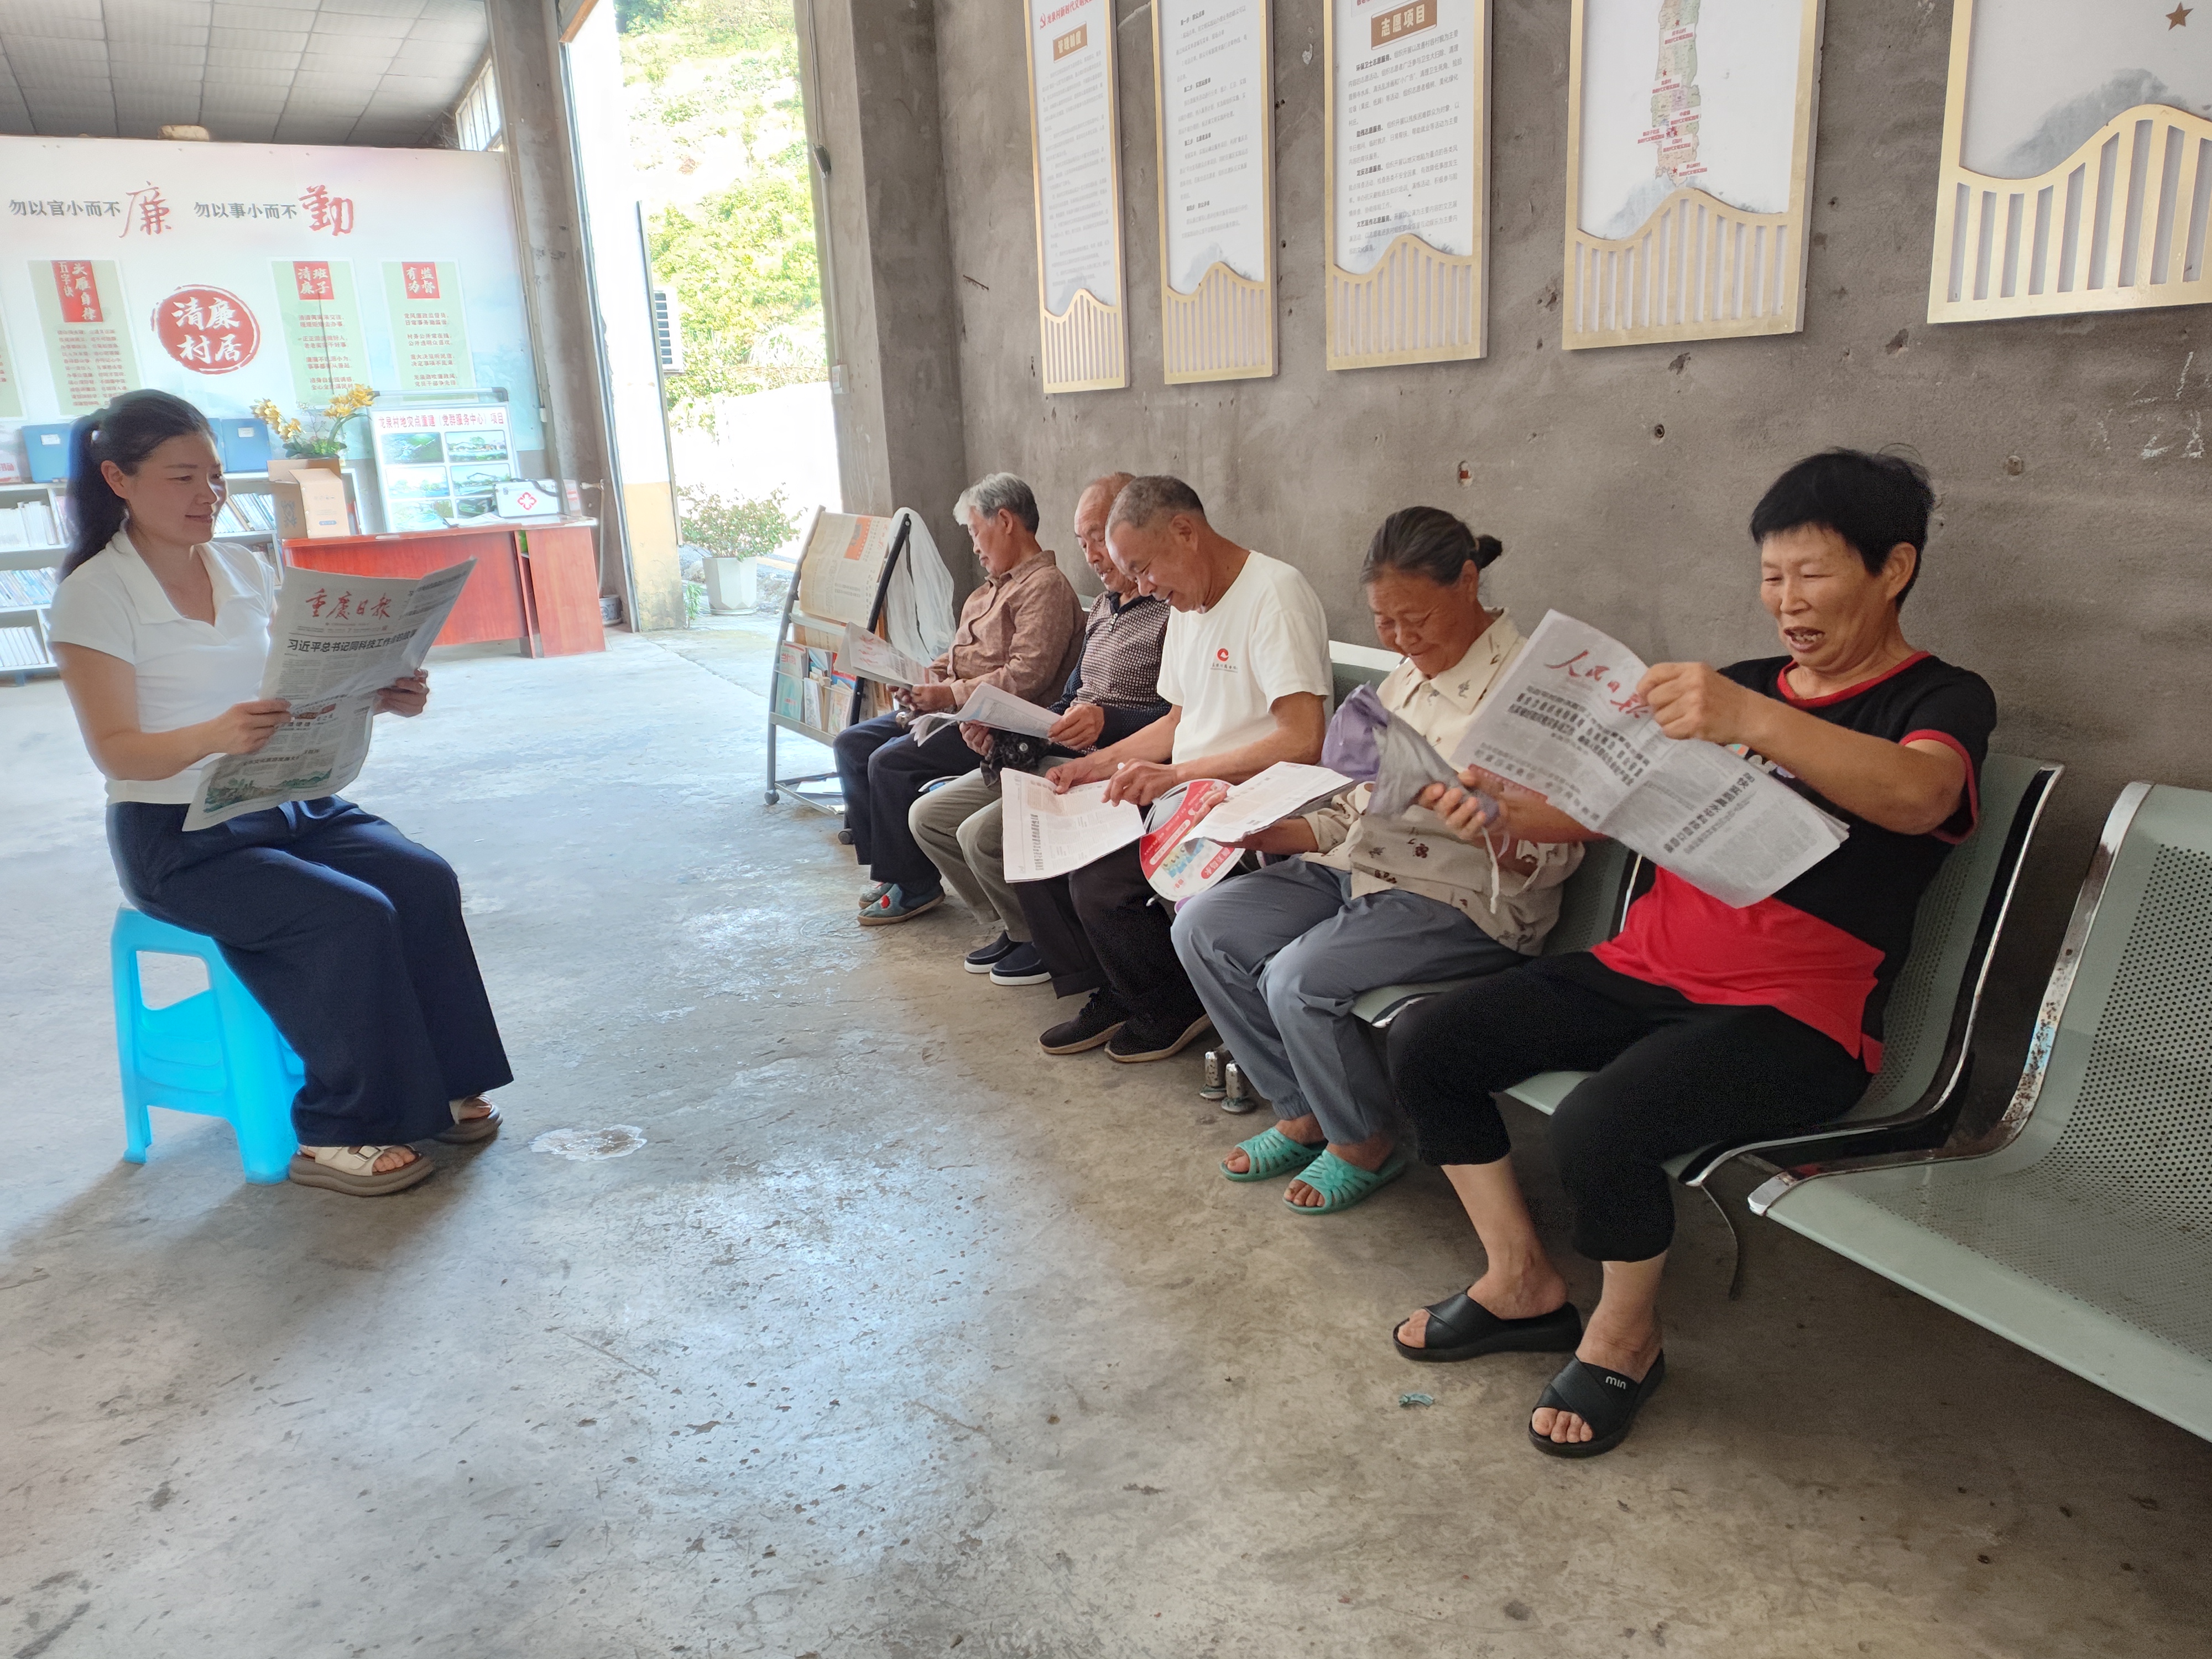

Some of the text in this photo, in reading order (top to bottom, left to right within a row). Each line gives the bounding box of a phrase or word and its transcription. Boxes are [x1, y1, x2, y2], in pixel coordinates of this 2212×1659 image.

[1381, 4, 1425, 37] 志愿项目
[1058, 30, 1081, 54] 管理制度
[171, 296, 242, 331] 清廉
[176, 334, 242, 364] 村居
[305, 588, 392, 620] 重庆日报
[1605, 1375, 1626, 1390] min
